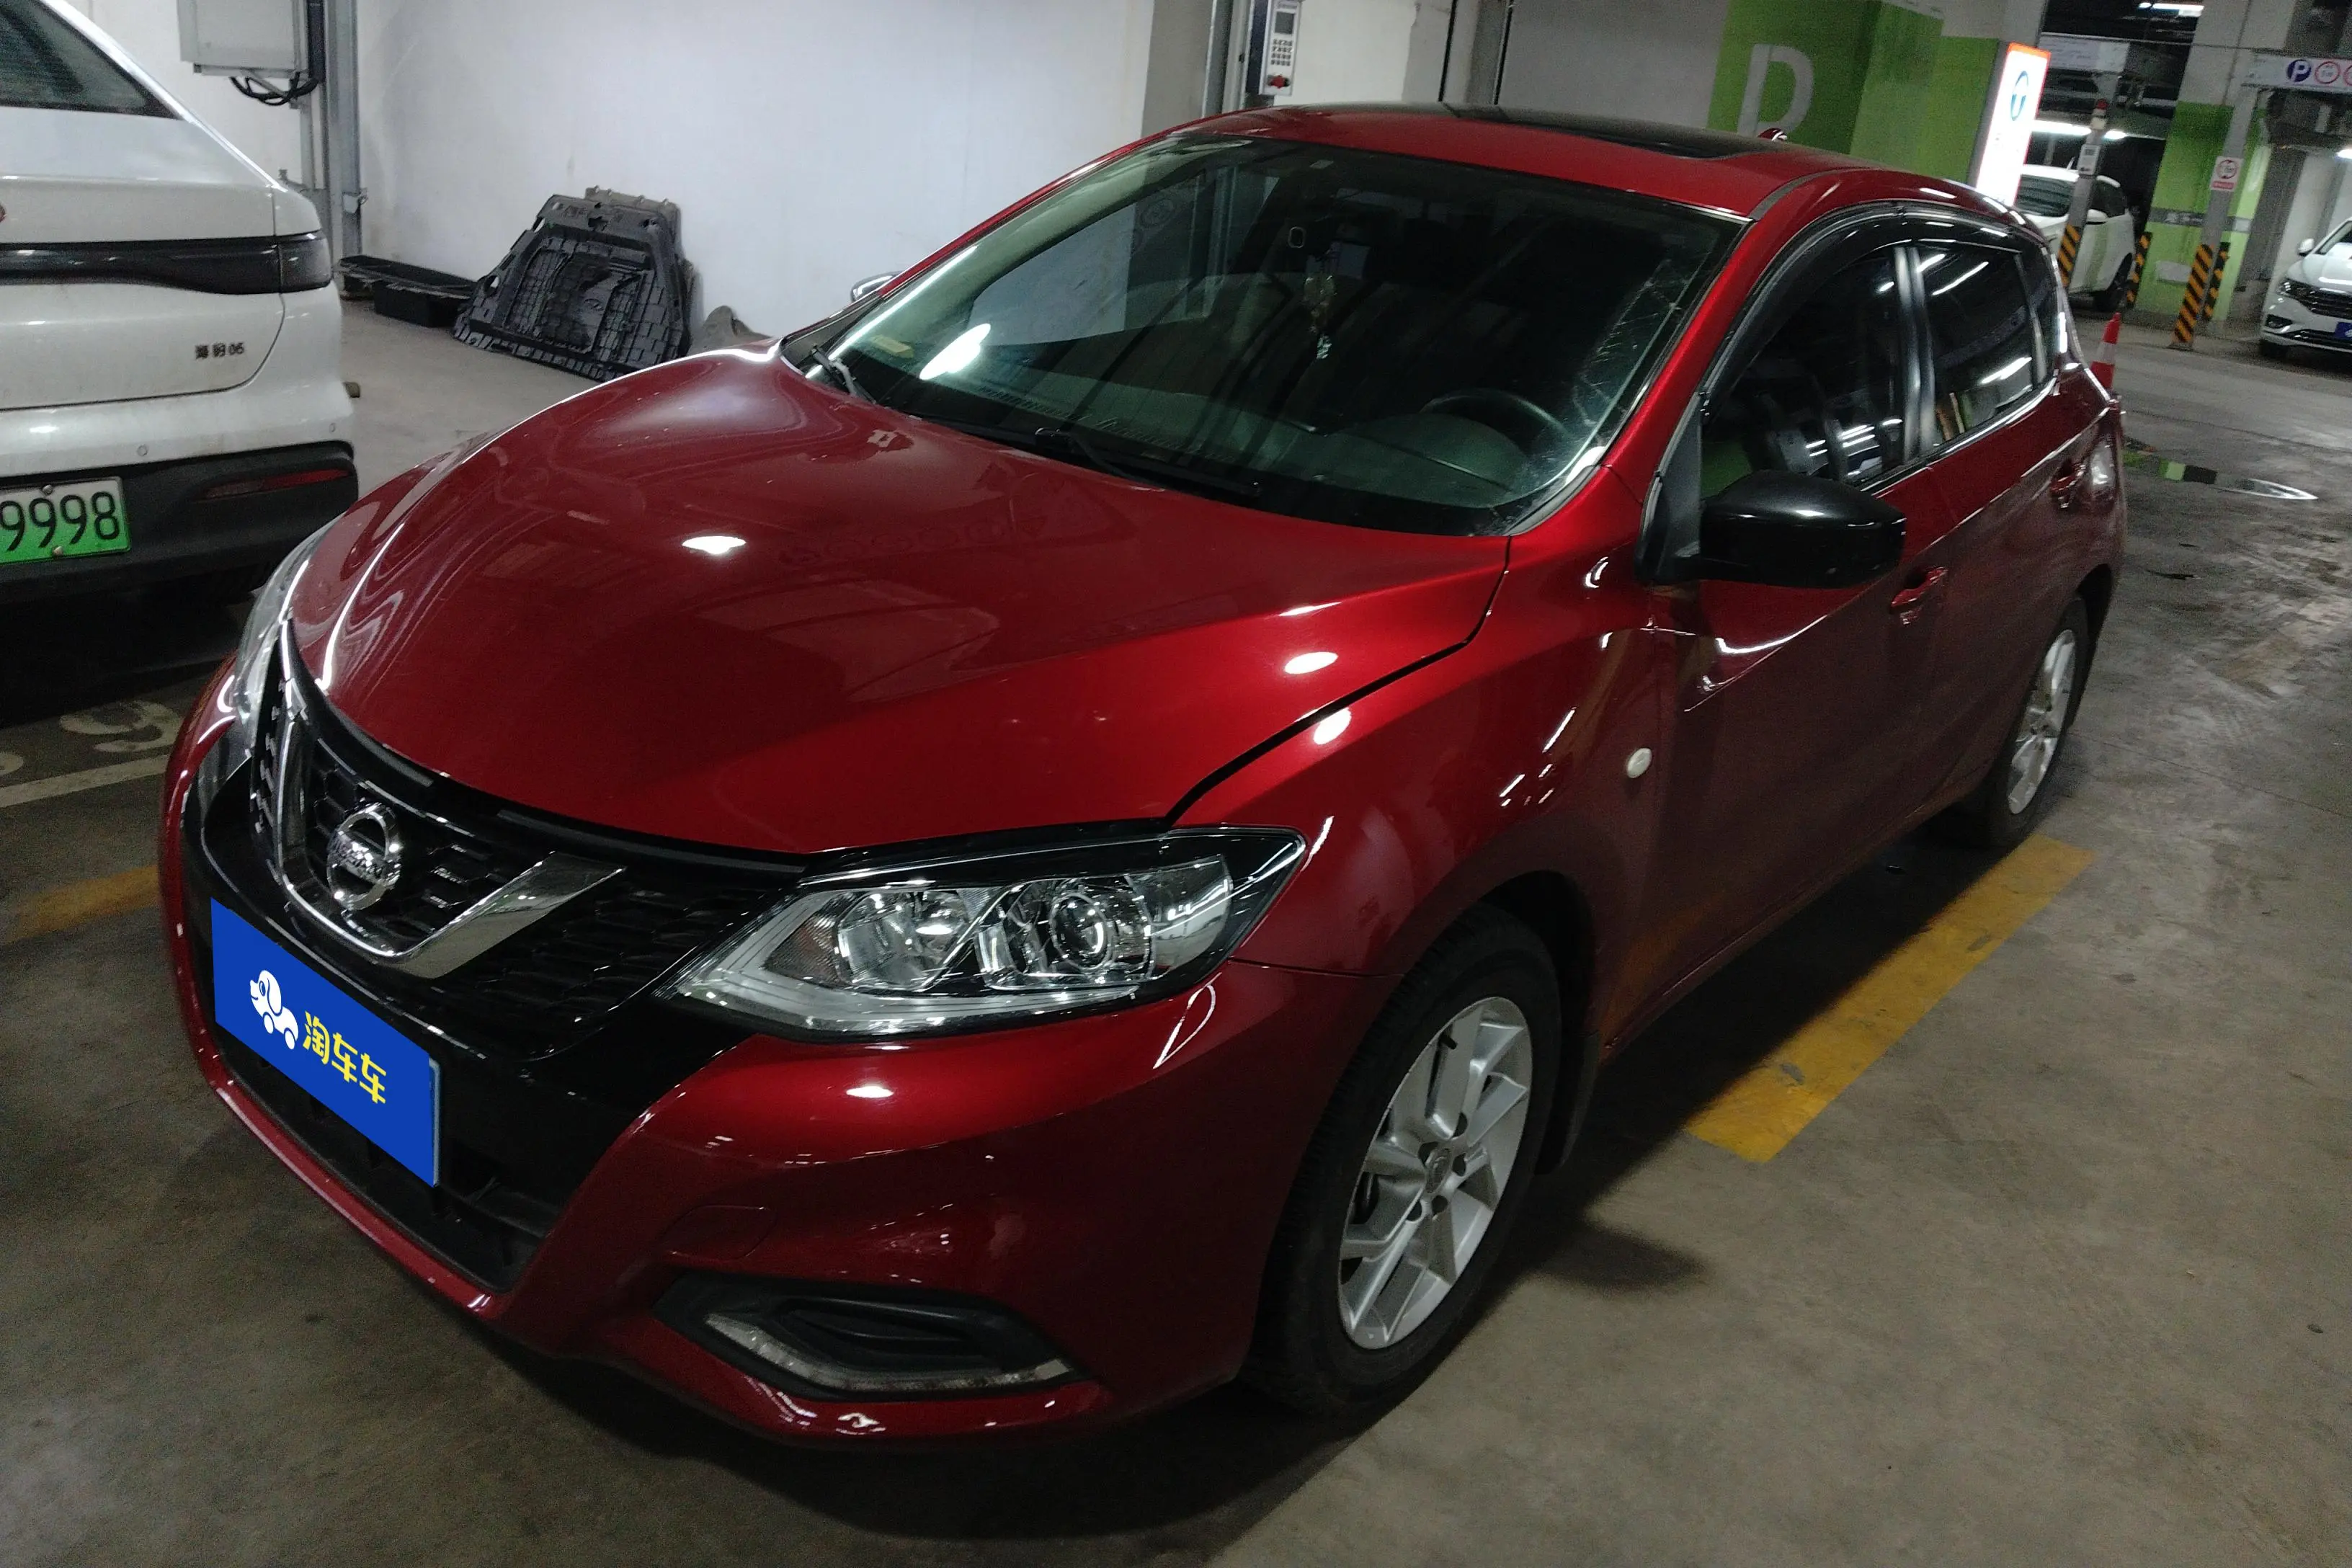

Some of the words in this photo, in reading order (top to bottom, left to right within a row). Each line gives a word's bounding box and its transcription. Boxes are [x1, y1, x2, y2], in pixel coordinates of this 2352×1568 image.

[1737, 44, 1814, 138] D
[2289, 60, 2310, 82] P
[0, 491, 120, 552] 9998
